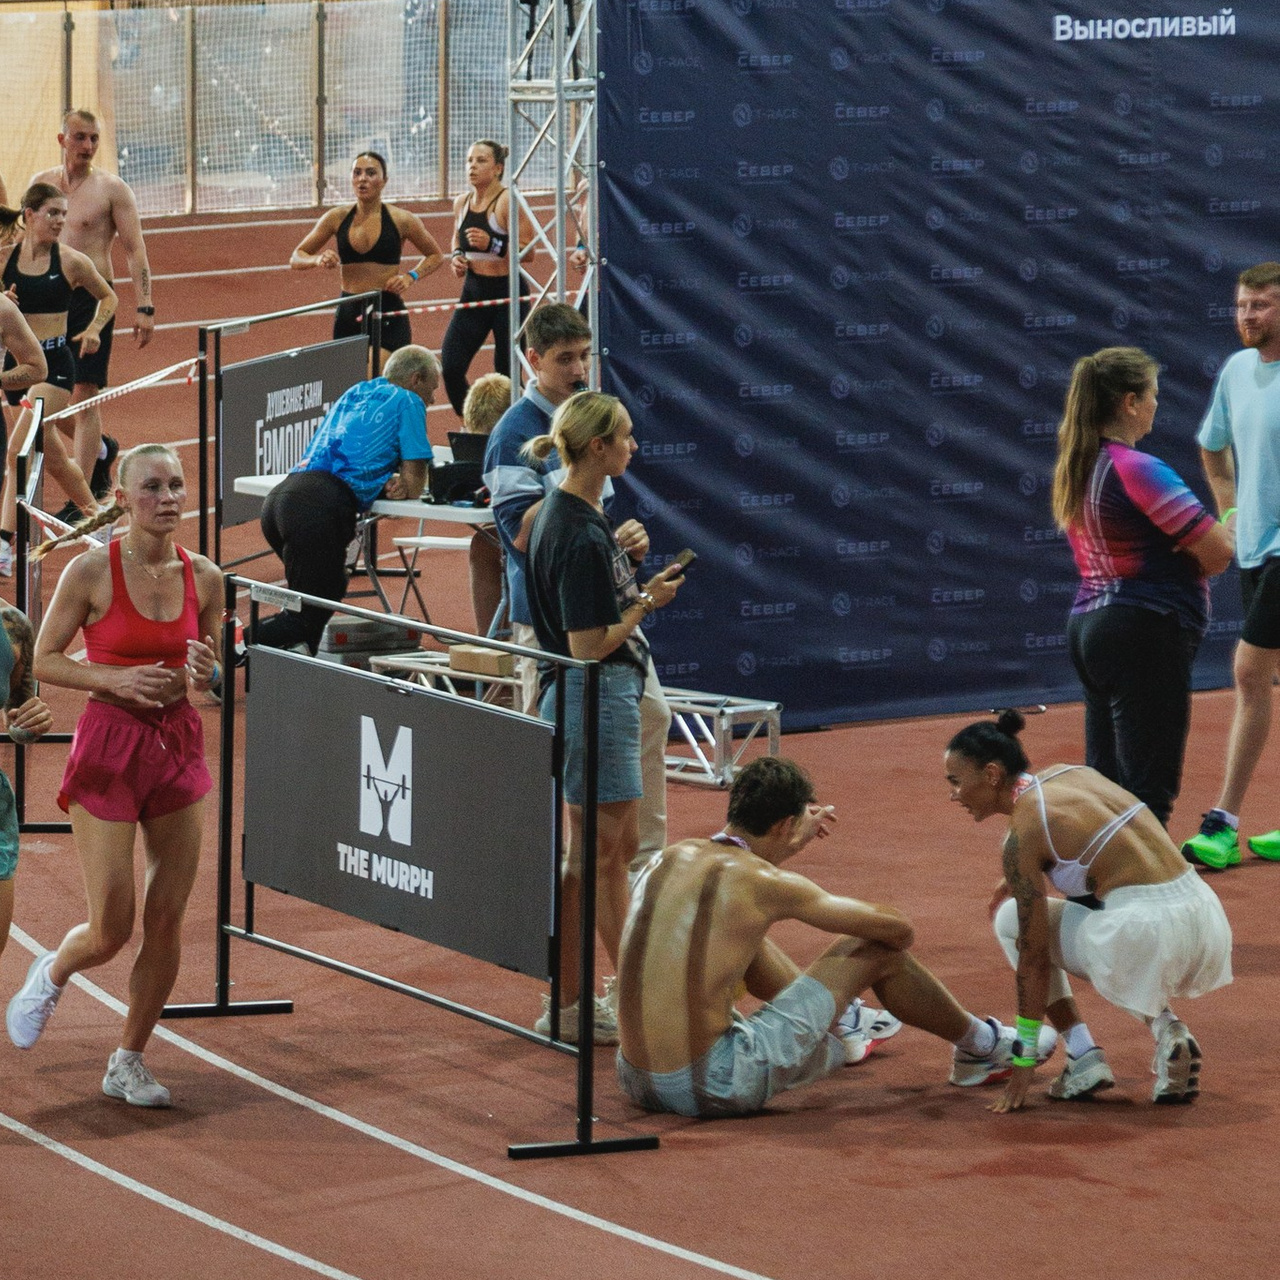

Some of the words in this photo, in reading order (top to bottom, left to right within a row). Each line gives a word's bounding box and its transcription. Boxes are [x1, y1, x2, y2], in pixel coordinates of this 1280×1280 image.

[1054, 8, 1237, 41] Выносливый
[637, 107, 695, 124] СЕВЕР
[833, 102, 891, 119] СЕВЕР
[1024, 634, 1066, 650] СЕВЕ
[336, 841, 370, 879] THE
[371, 852, 434, 900] MURPH
